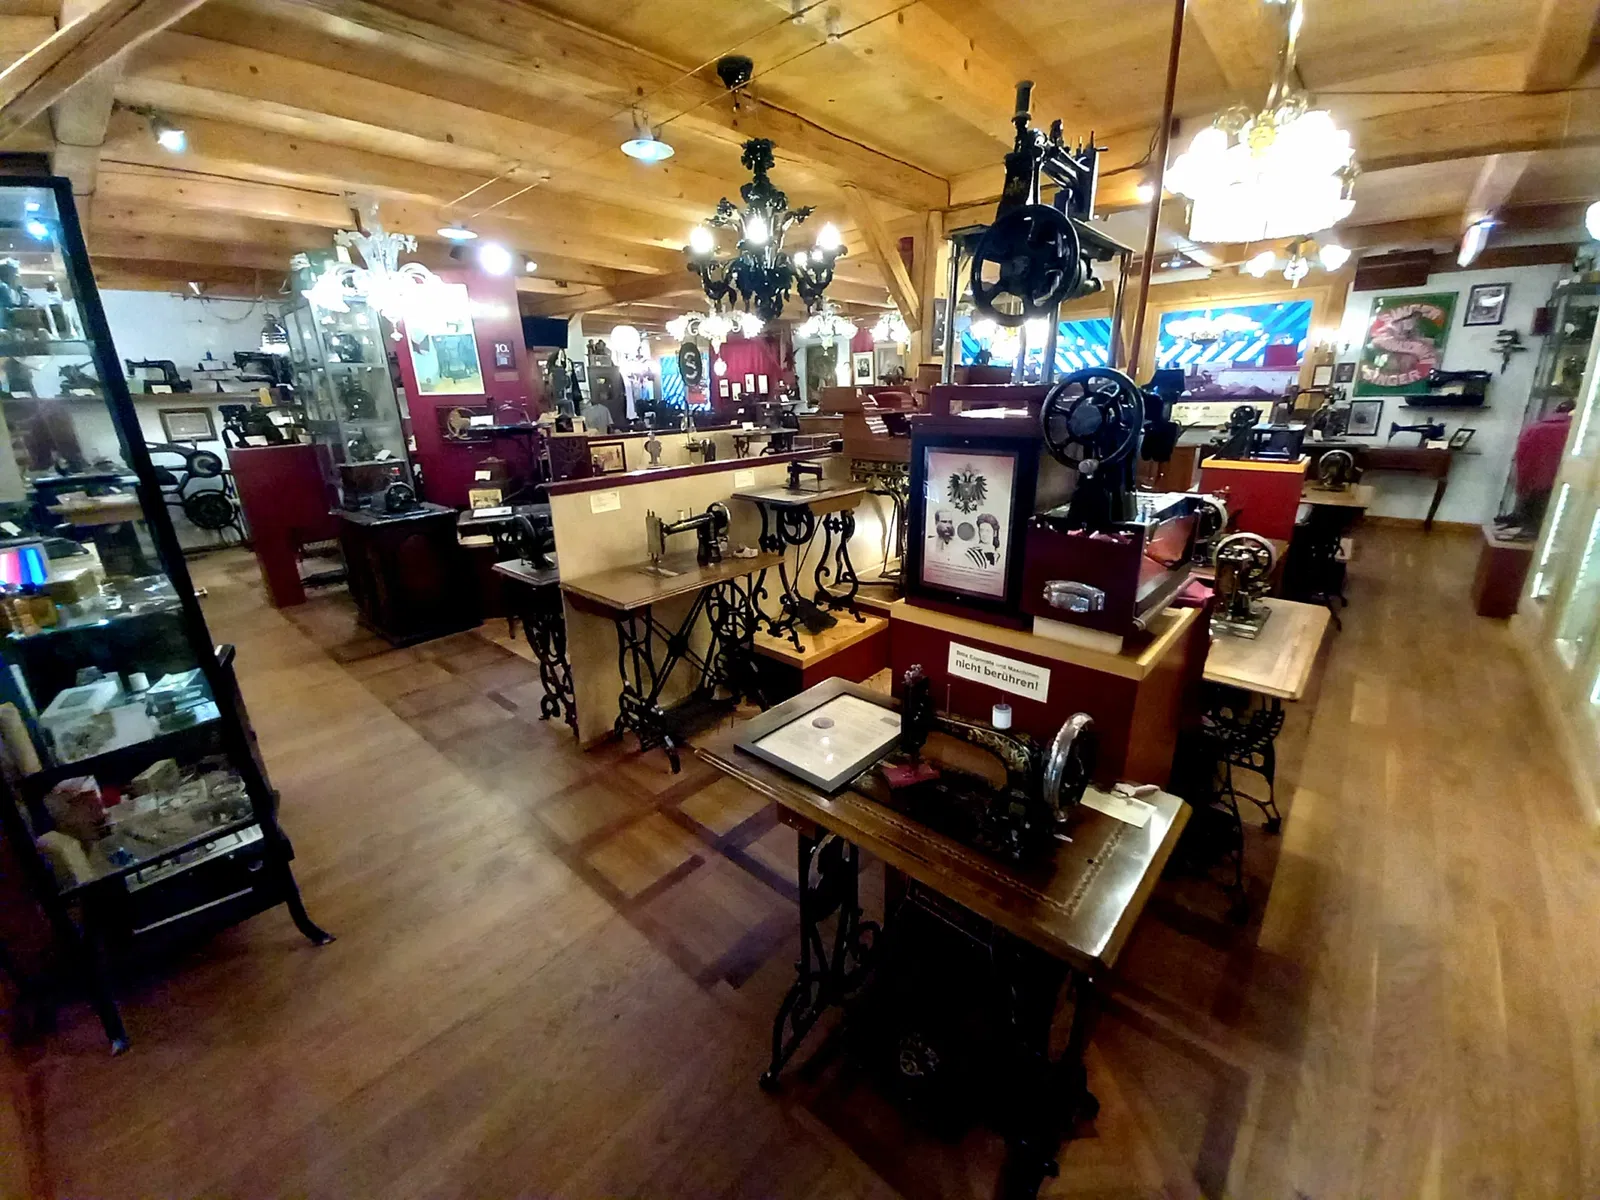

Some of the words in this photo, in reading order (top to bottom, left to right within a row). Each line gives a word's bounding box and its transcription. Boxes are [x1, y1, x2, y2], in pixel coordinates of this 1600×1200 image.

[495, 344, 509, 352] 10.
[1361, 365, 1422, 386] SINGER
[955, 659, 982, 673] nicht
[984, 666, 1039, 691] berühren!
